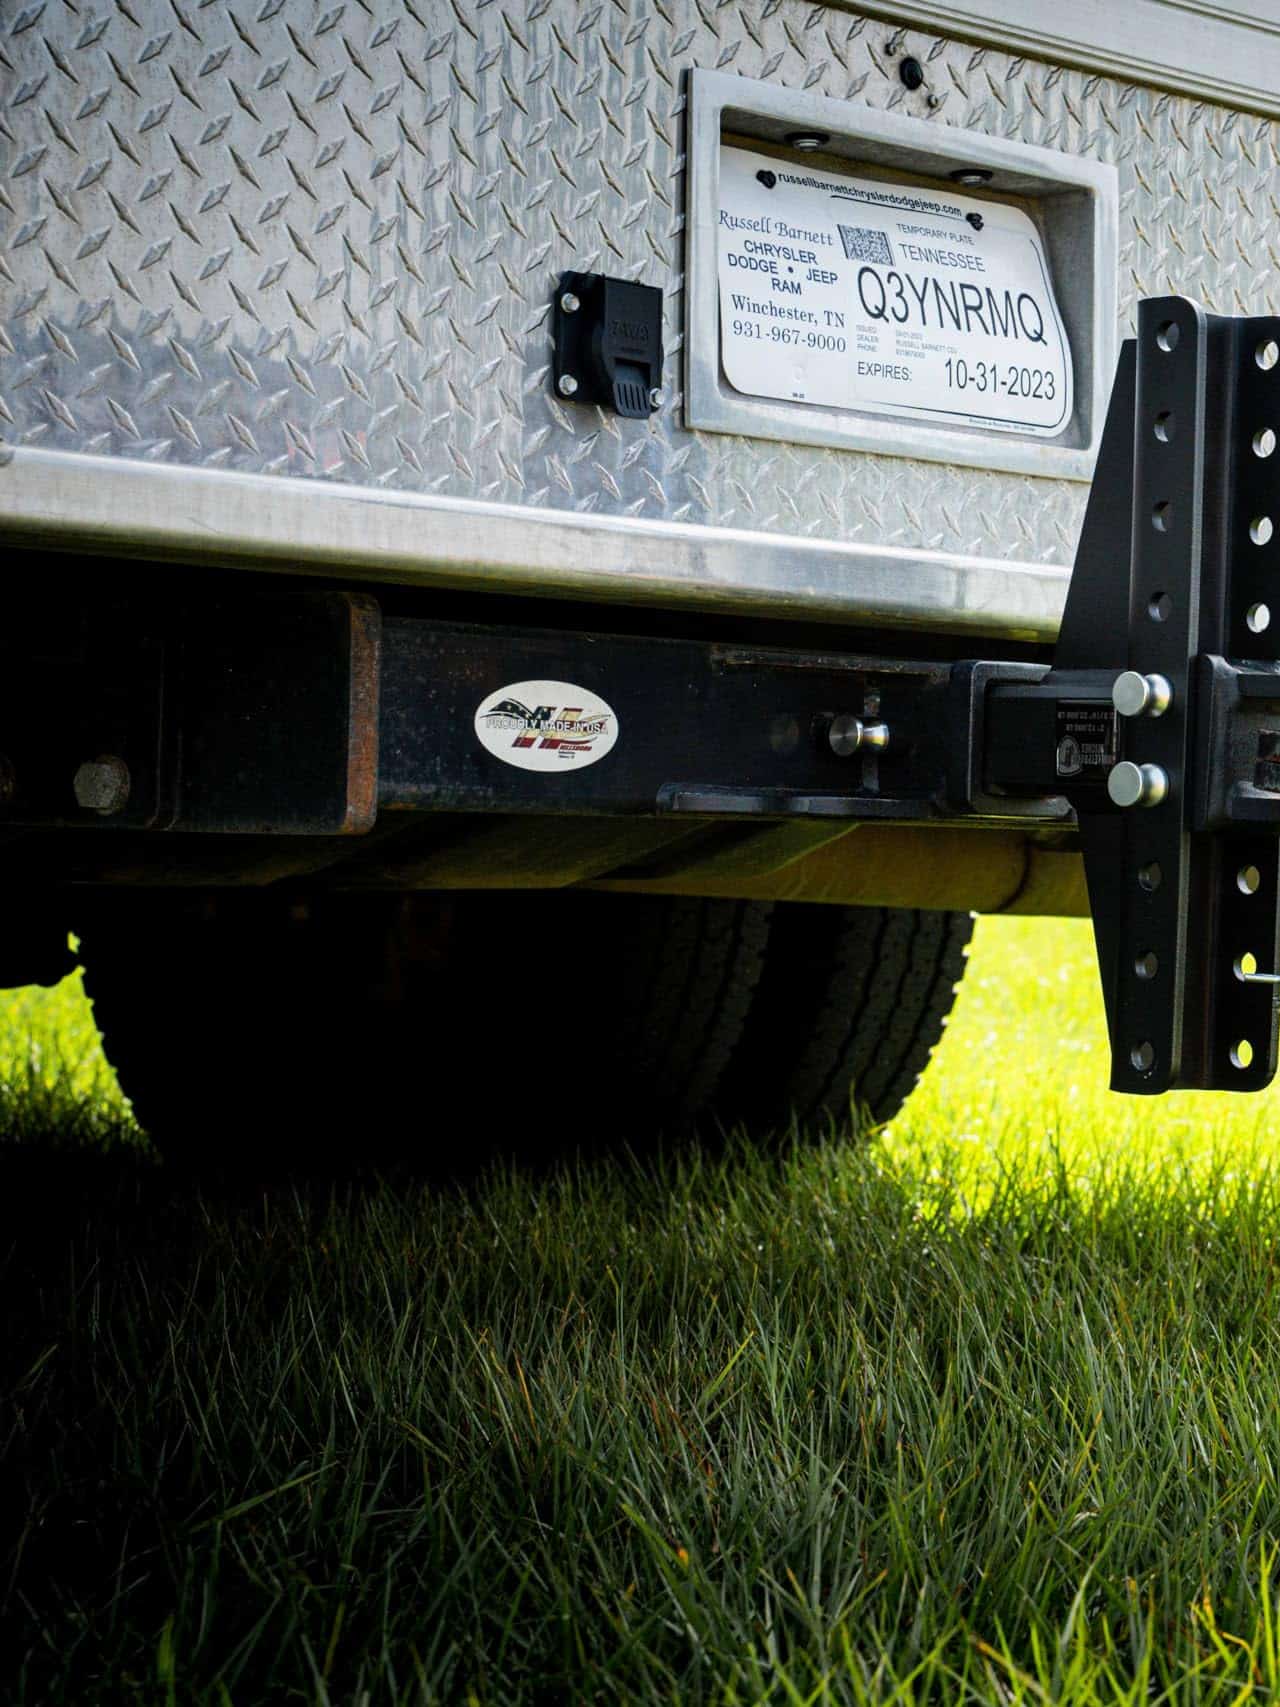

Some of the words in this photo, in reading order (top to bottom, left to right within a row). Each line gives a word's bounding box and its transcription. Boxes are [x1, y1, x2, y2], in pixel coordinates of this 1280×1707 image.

[778, 171, 962, 216] russellbarnettchryslerdodgejeep.com
[719, 210, 770, 234] Russell
[774, 221, 833, 246] Barnett
[896, 223, 947, 241] TEMPORARY
[949, 231, 975, 246] PLATE
[743, 239, 817, 265] CHRYSLER
[898, 242, 985, 272] TENNESSEE
[728, 253, 778, 275] DODGE
[806, 264, 838, 285] JEEP
[772, 277, 801, 295] RAM
[732, 294, 817, 326] Winchester,
[824, 311, 845, 328] TN
[857, 266, 1048, 346] Q3YNRMQ
[733, 319, 846, 353] 931-967-9000
[858, 361, 912, 382] EXPIRES:
[945, 358, 1055, 400] 10-31-2023
[486, 718, 537, 730] PROUDLY
[540, 720, 570, 731] MADE
[573, 721, 586, 732] IN
[586, 722, 608, 735] USA
